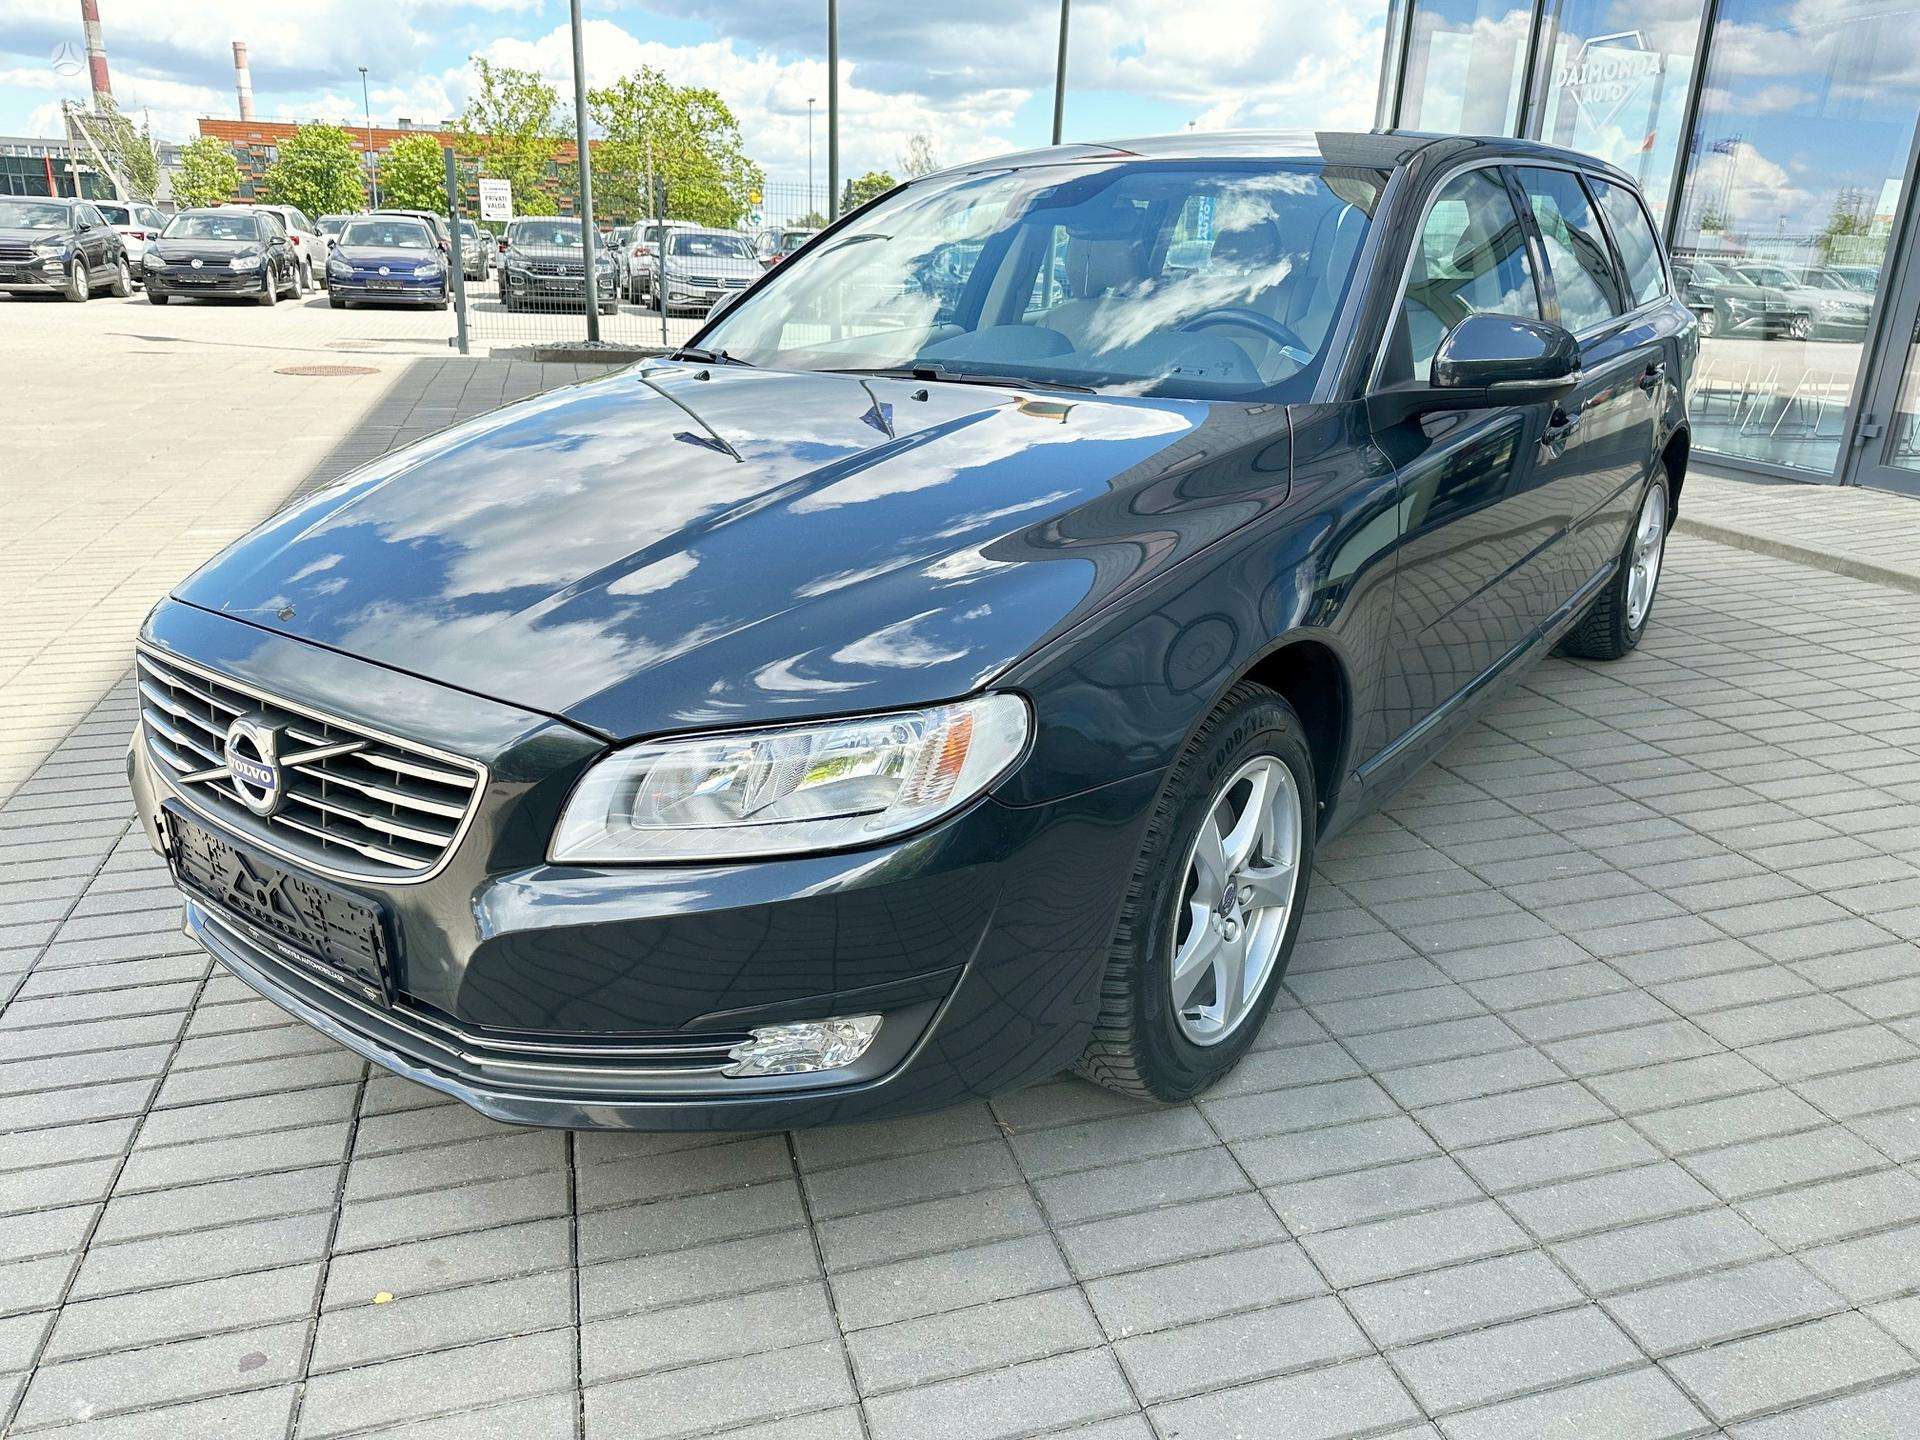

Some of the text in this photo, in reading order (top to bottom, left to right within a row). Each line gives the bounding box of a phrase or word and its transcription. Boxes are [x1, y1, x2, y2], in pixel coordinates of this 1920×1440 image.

[1557, 57, 1661, 88] DAIMONDA
[1581, 83, 1624, 104] AUTO
[227, 754, 272, 784] VOLVO
